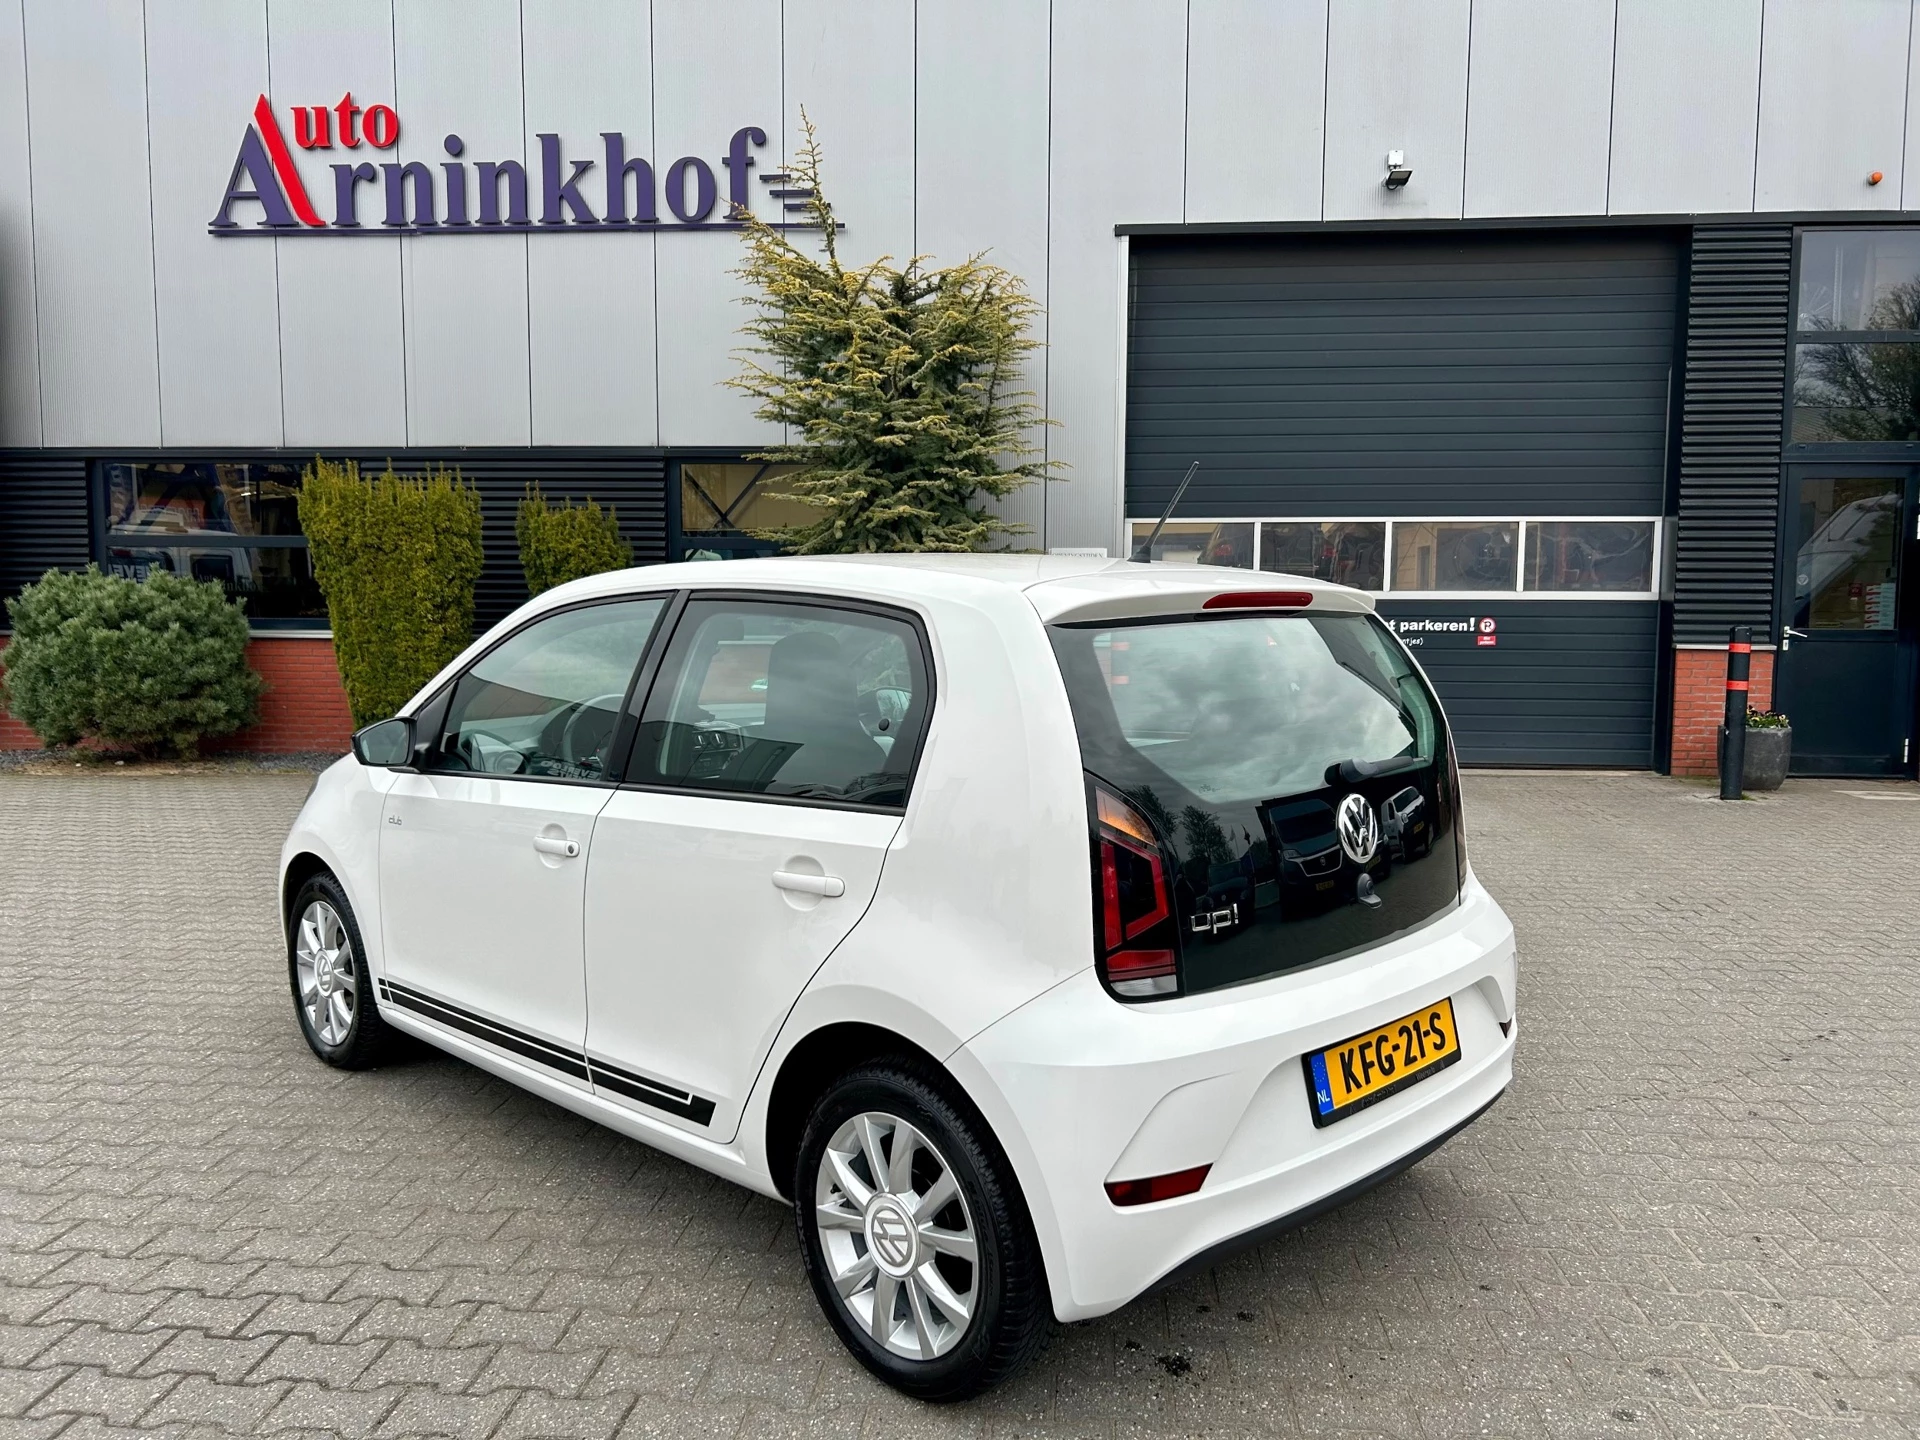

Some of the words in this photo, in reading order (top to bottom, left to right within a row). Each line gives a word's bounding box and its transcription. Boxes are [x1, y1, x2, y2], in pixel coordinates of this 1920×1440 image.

[208, 122, 767, 226] Arninkhof
[1400, 617, 1475, 633] parkeren!
[1402, 637, 1423, 646] ntjes)
[1190, 902, 1239, 934] up!
[1339, 1011, 1447, 1095] KFG-21-S
[1316, 1088, 1331, 1105] NL
